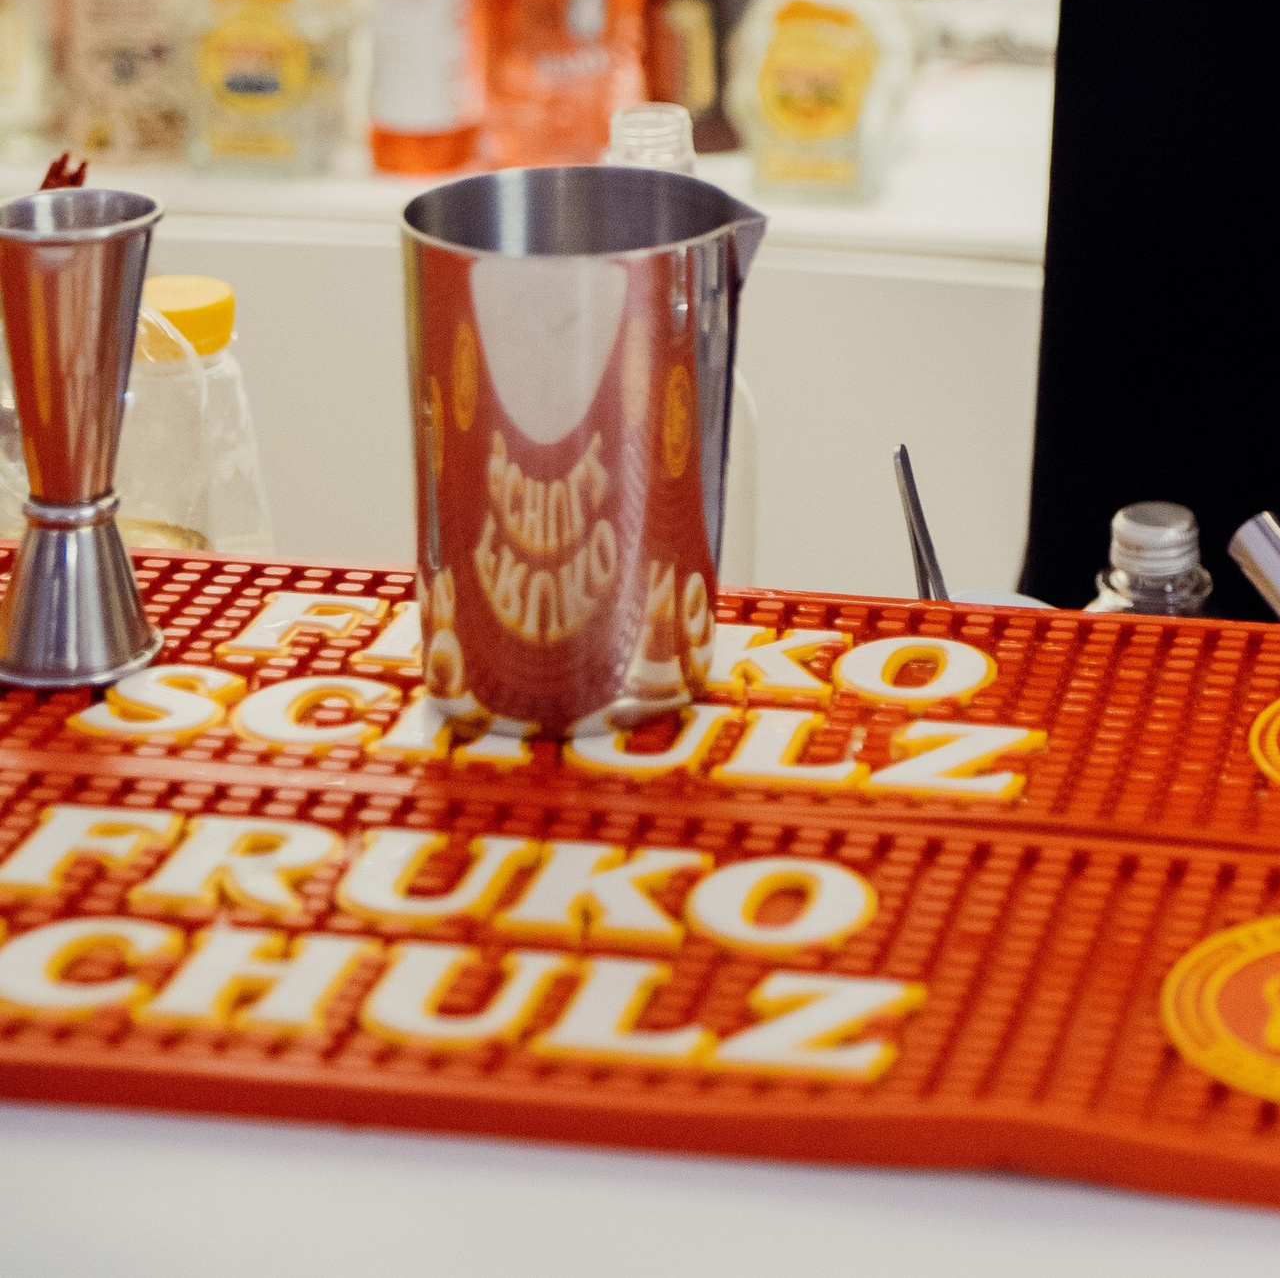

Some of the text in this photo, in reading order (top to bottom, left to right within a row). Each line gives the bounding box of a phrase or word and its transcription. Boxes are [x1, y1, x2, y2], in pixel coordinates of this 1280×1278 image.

[215, 591, 998, 709] FKO
[0, 804, 878, 959] FRUKO
[0, 916, 927, 1083] CHULZ
